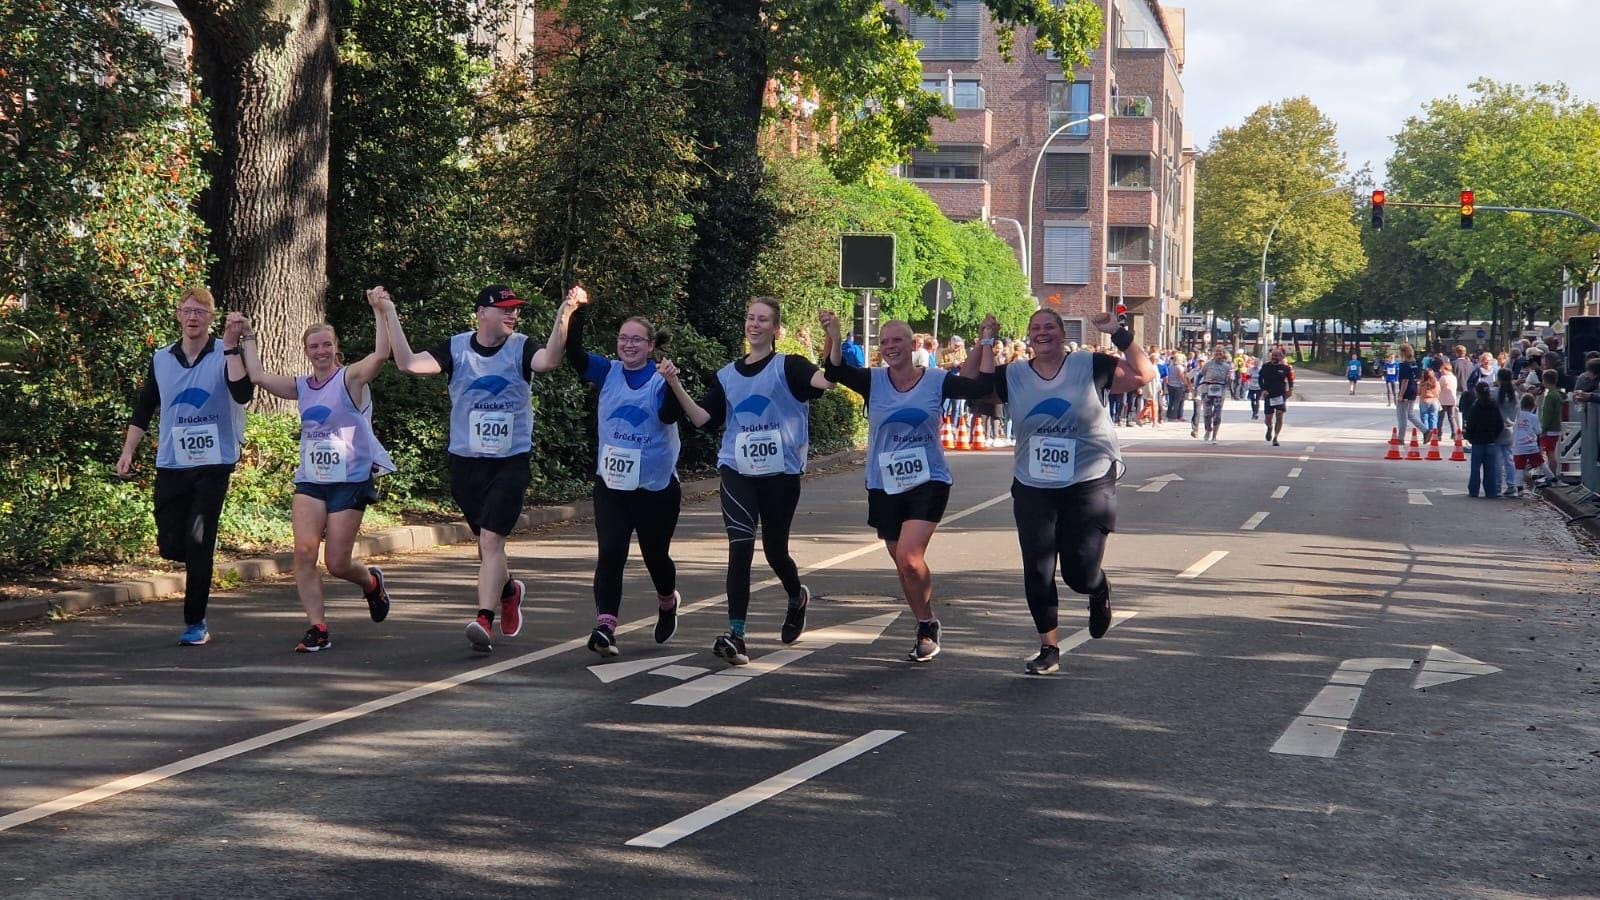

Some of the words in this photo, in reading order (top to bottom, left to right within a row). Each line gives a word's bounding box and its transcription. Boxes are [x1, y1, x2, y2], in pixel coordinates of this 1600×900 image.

[474, 422, 509, 437] 1204
[179, 435, 214, 450] 1205
[741, 442, 778, 458] 1206
[309, 451, 340, 465] 1203
[1034, 448, 1069, 464] 1208
[604, 456, 634, 473] 1207
[886, 459, 923, 477] 1209
